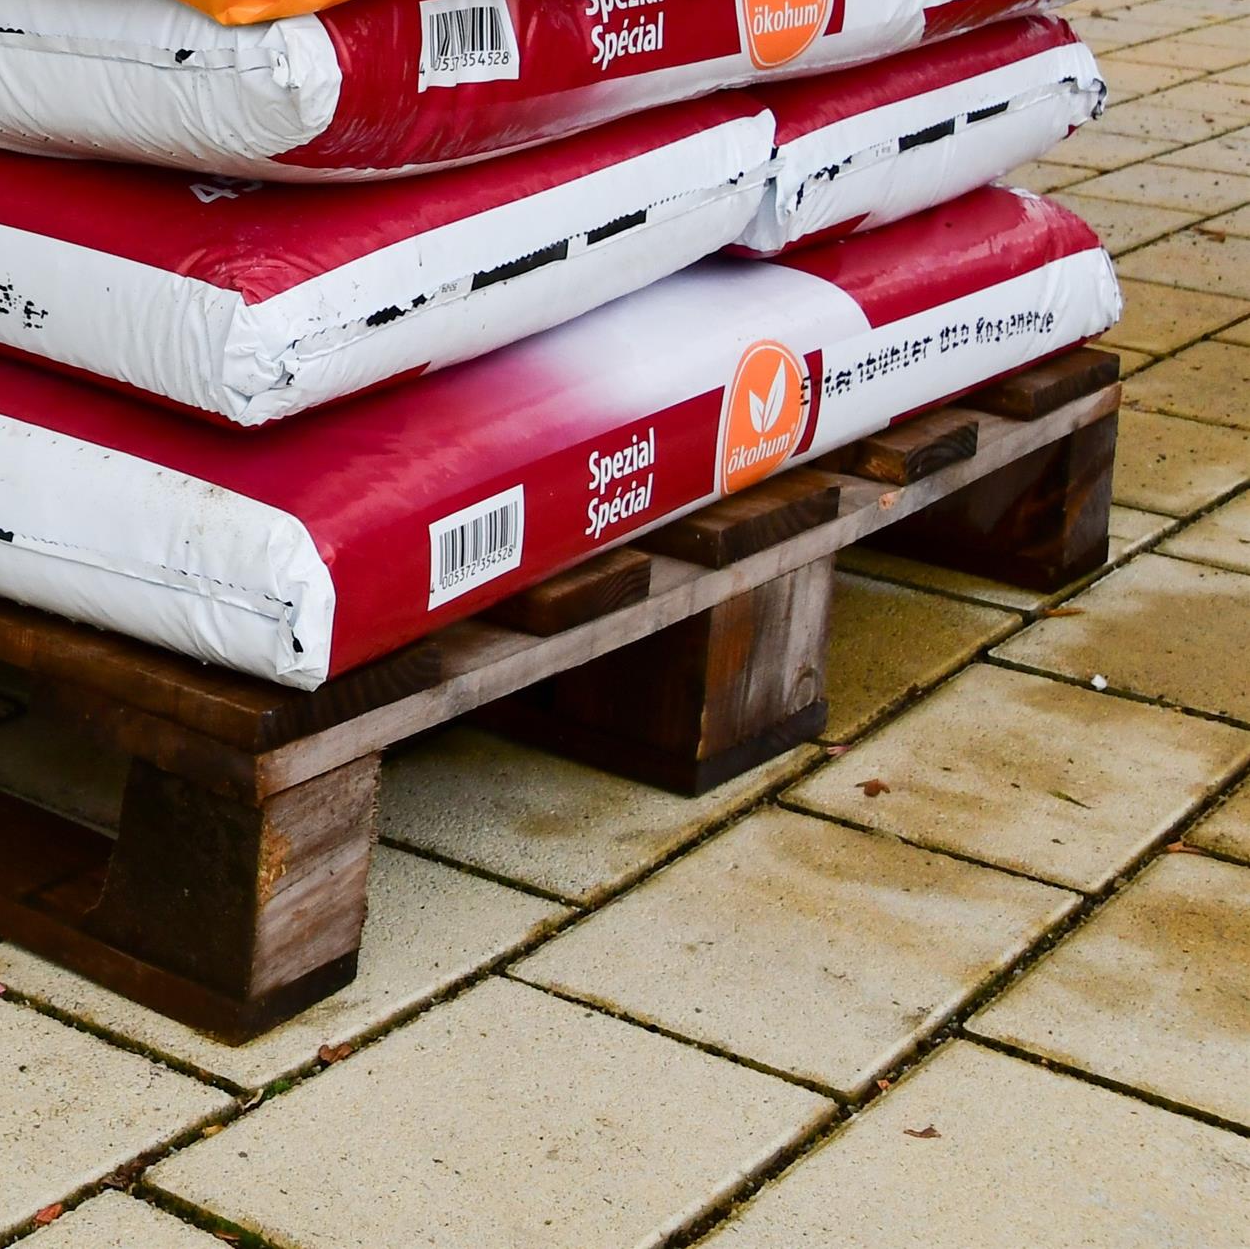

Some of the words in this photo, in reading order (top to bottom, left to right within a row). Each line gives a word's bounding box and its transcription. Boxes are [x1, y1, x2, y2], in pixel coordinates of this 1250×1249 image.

[590, 12, 665, 71] Spécial
[752, 3, 819, 36] ökohum
[588, 427, 655, 491] Spezial
[726, 433, 791, 476] ökohum
[585, 472, 654, 539] Spécial
